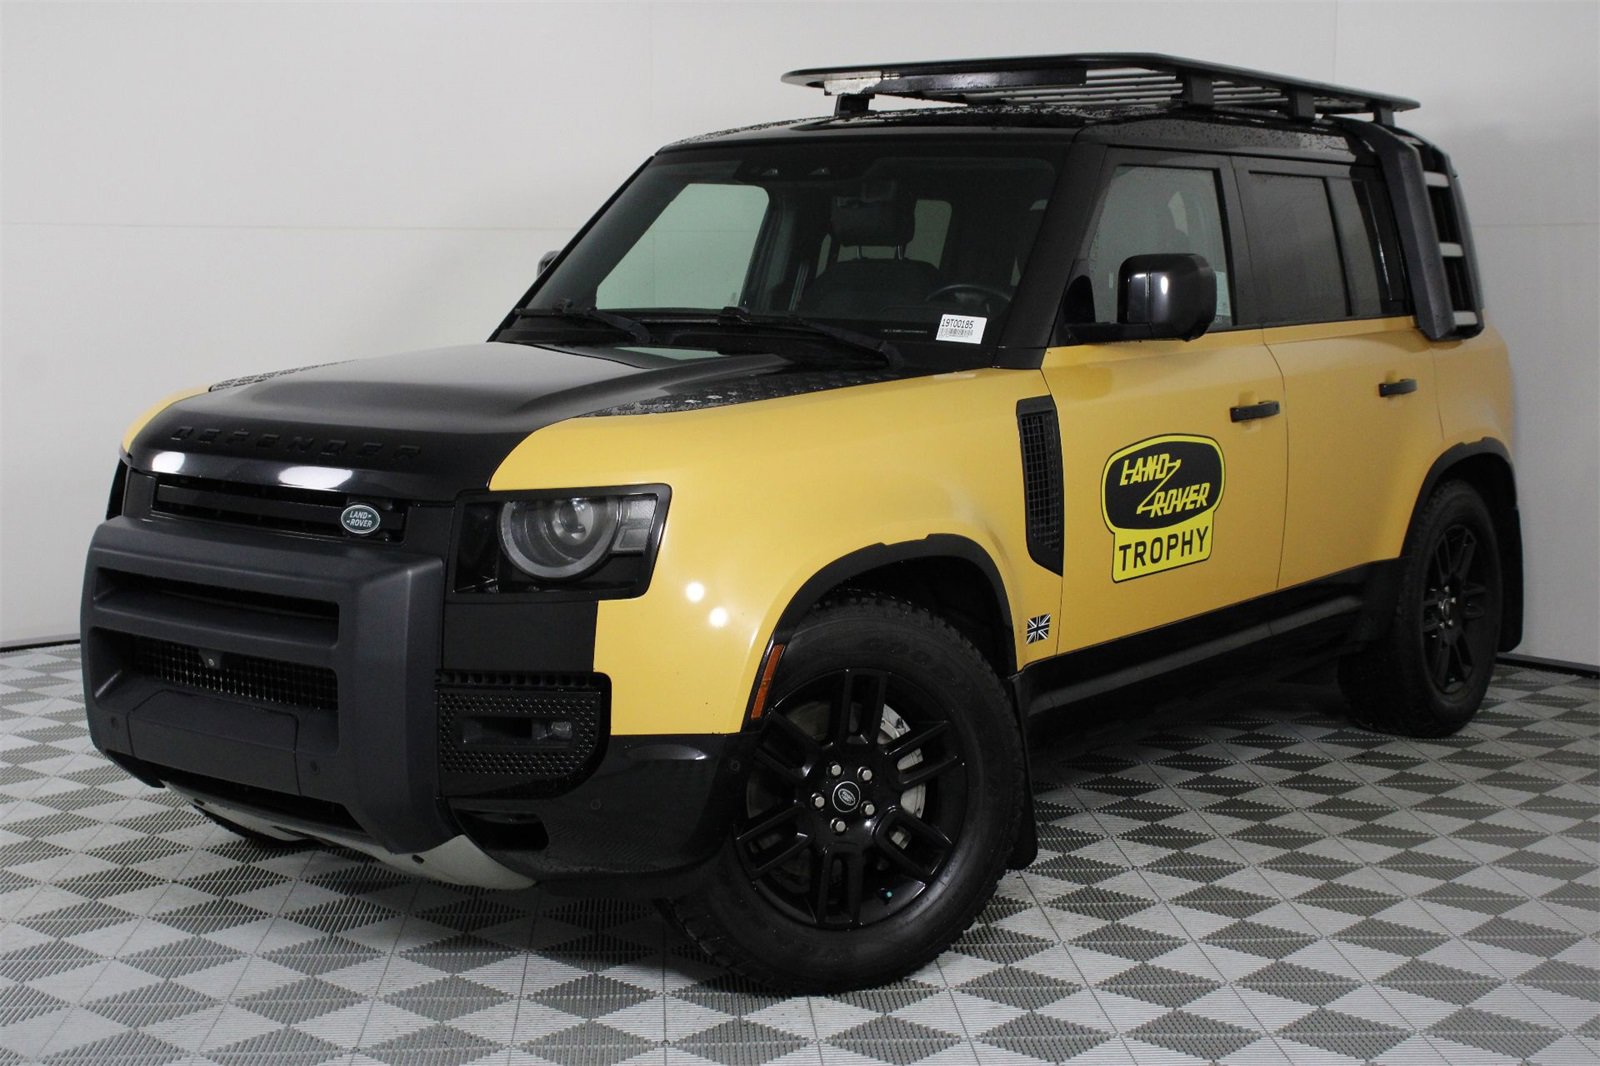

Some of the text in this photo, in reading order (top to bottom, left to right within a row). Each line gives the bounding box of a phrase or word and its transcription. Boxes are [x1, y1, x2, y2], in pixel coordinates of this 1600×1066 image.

[1119, 453, 1171, 486] LAND
[350, 511, 368, 519] LAND
[1150, 482, 1211, 518] ROVER
[350, 519, 372, 527] ROVER
[1119, 526, 1208, 571] TROPHY
